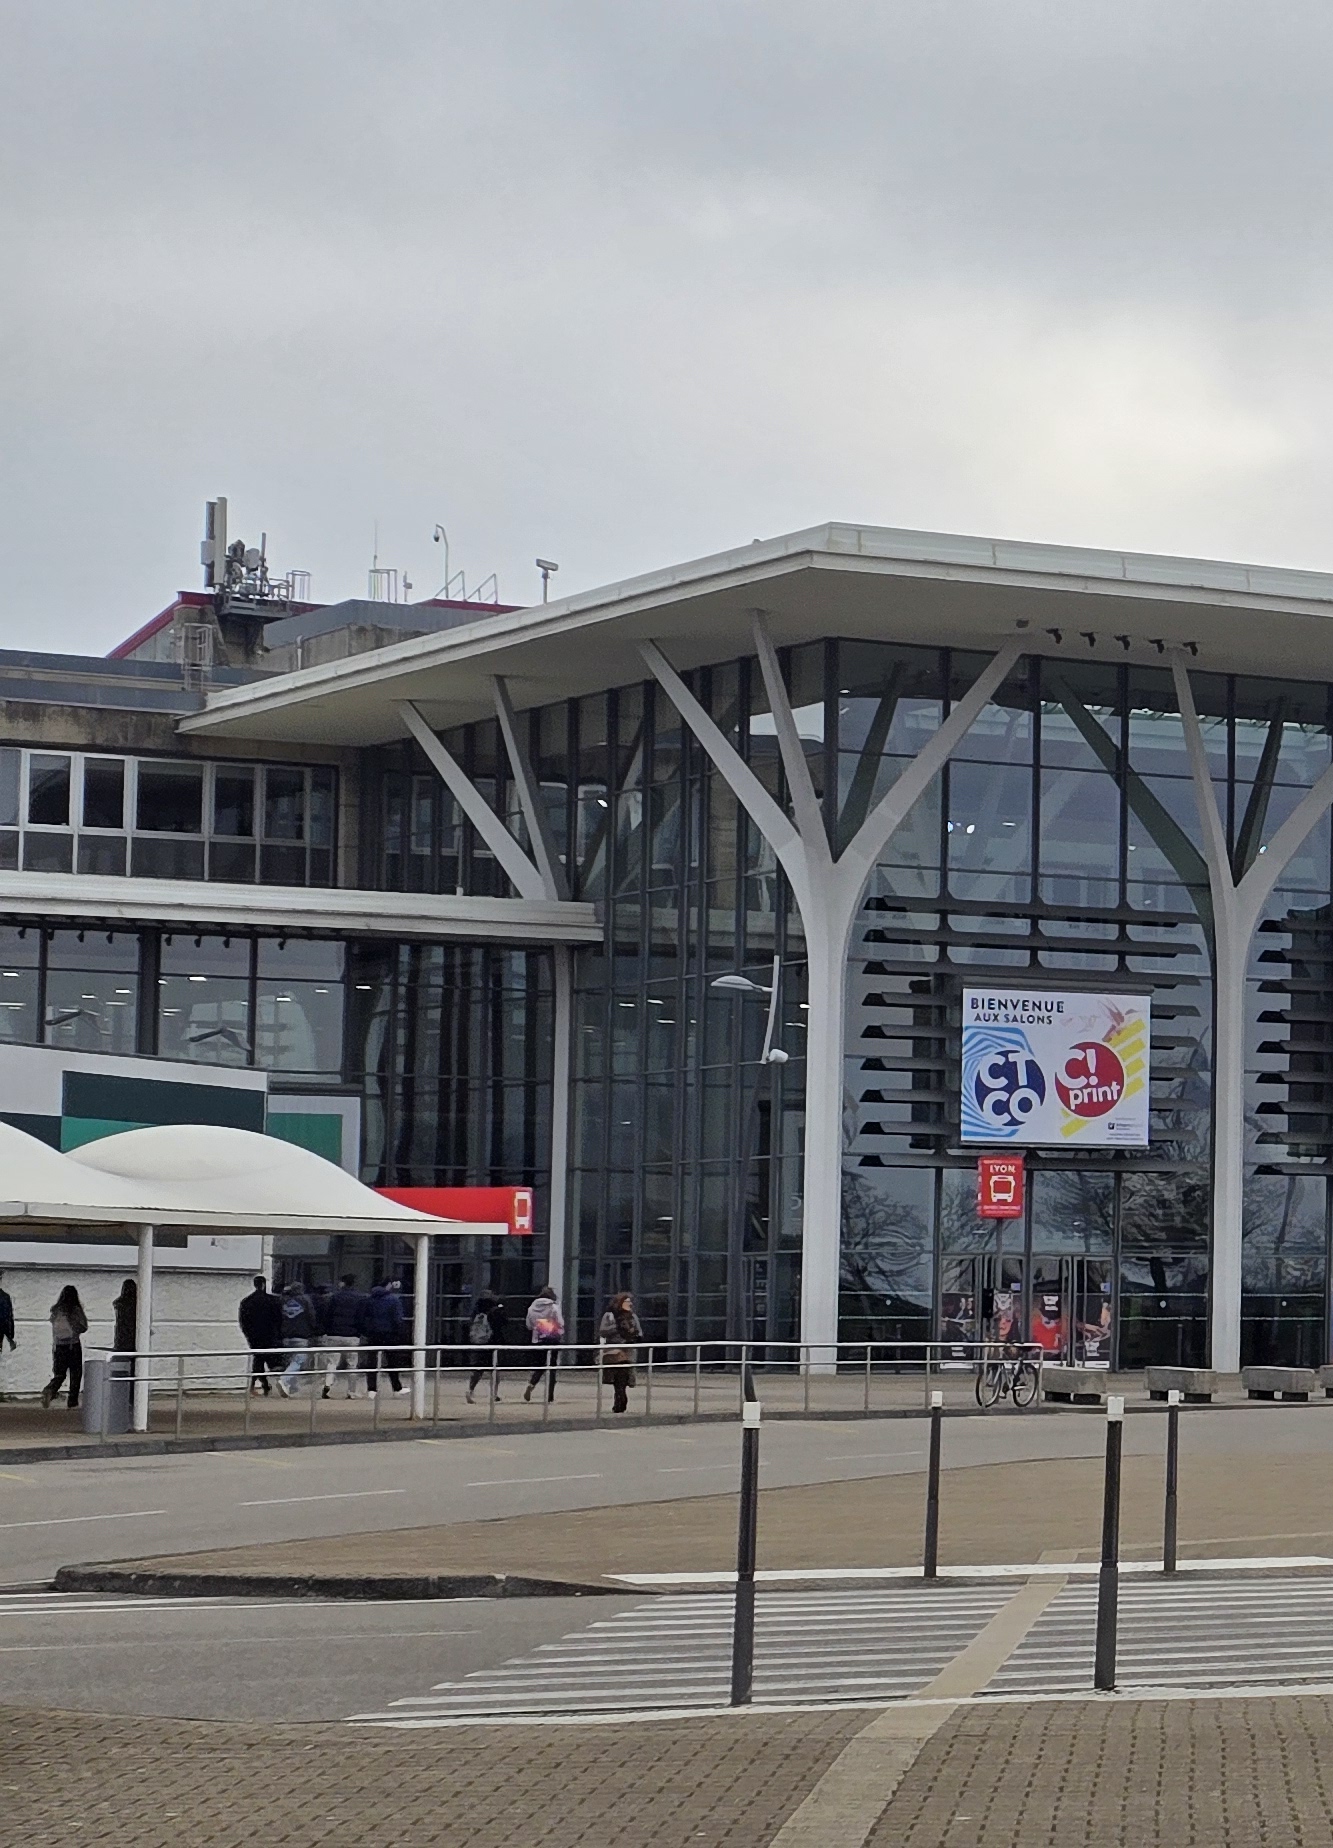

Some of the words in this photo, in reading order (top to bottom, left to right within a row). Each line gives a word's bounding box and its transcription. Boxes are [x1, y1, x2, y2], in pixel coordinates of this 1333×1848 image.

[970, 997, 1065, 1014] BIENVENUE
[974, 1013, 999, 1023] AUX
[1003, 1013, 1053, 1025] SALONS
[1069, 1081, 1121, 1110] print
[989, 1164, 1016, 1173] LYON
